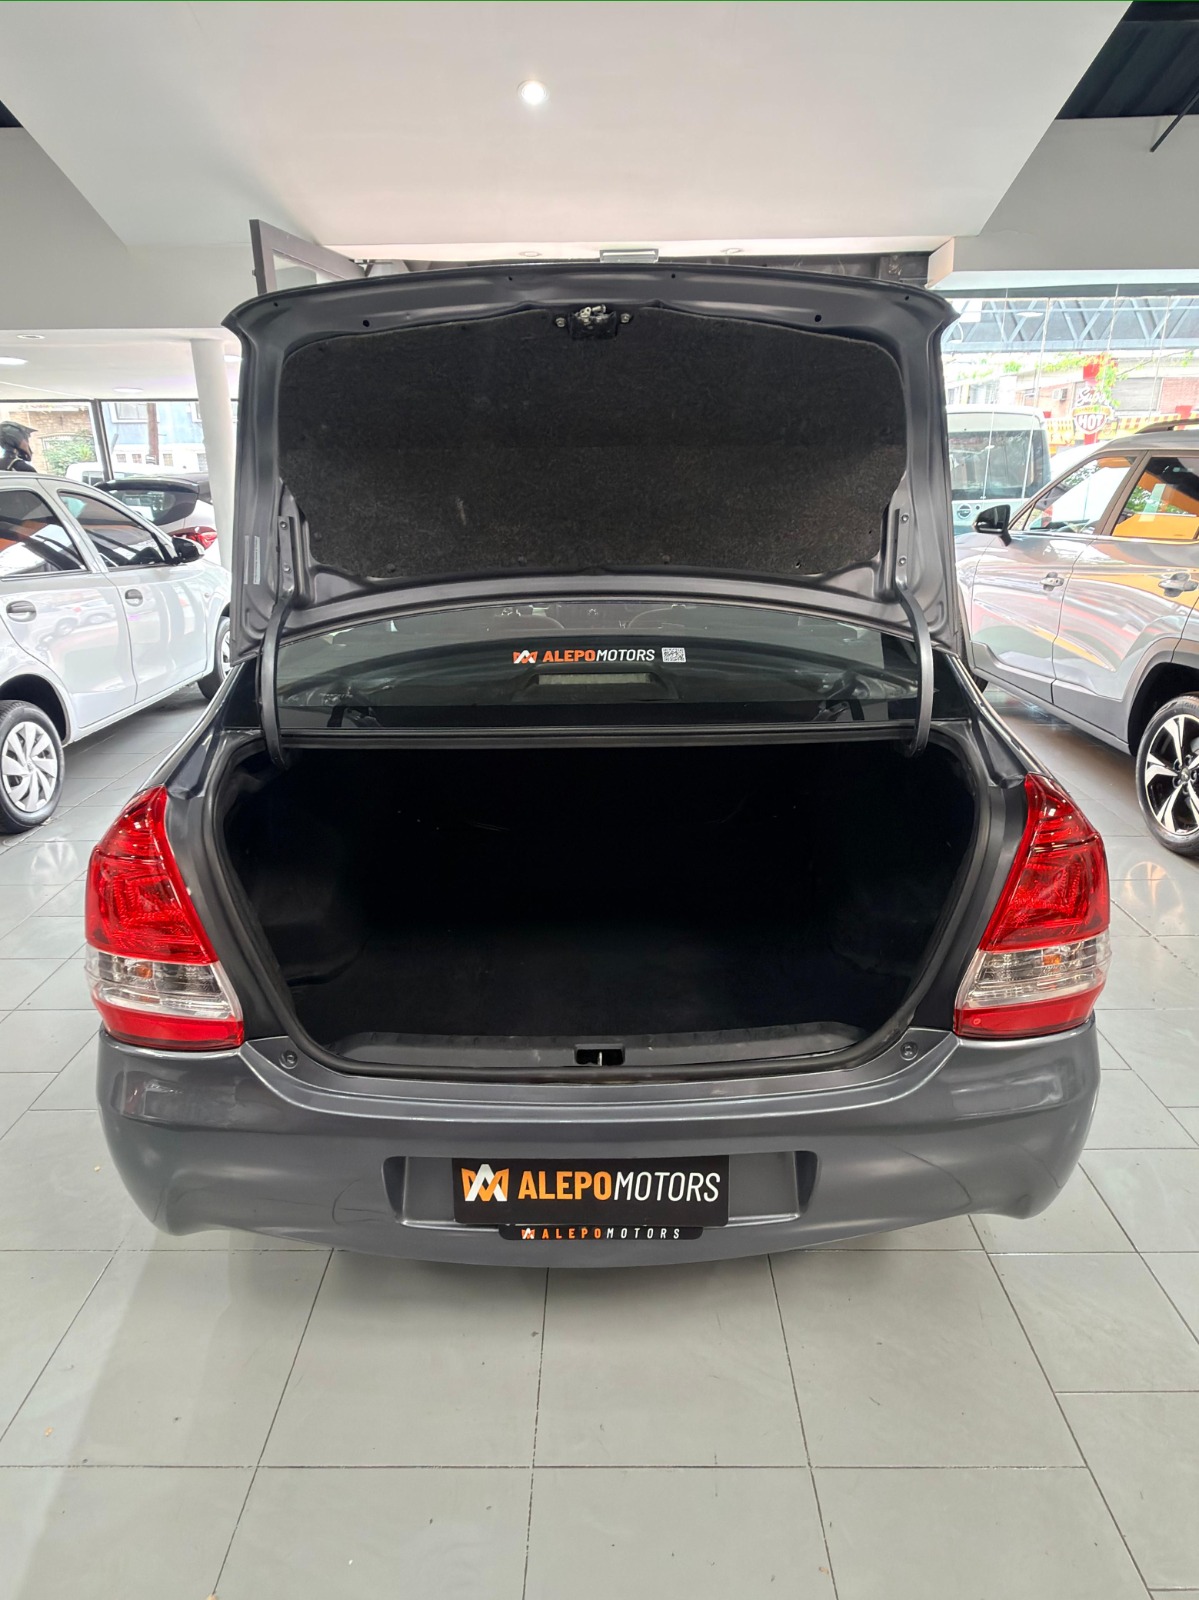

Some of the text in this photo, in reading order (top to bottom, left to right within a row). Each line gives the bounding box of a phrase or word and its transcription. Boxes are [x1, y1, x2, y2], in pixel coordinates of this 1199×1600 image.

[1078, 414, 1105, 430] HOT
[543, 650, 655, 662] ALEPOMOTORS
[518, 1170, 721, 1202] ALEPOMOTORS
[541, 1226, 680, 1239] ALEPOMOTORS
